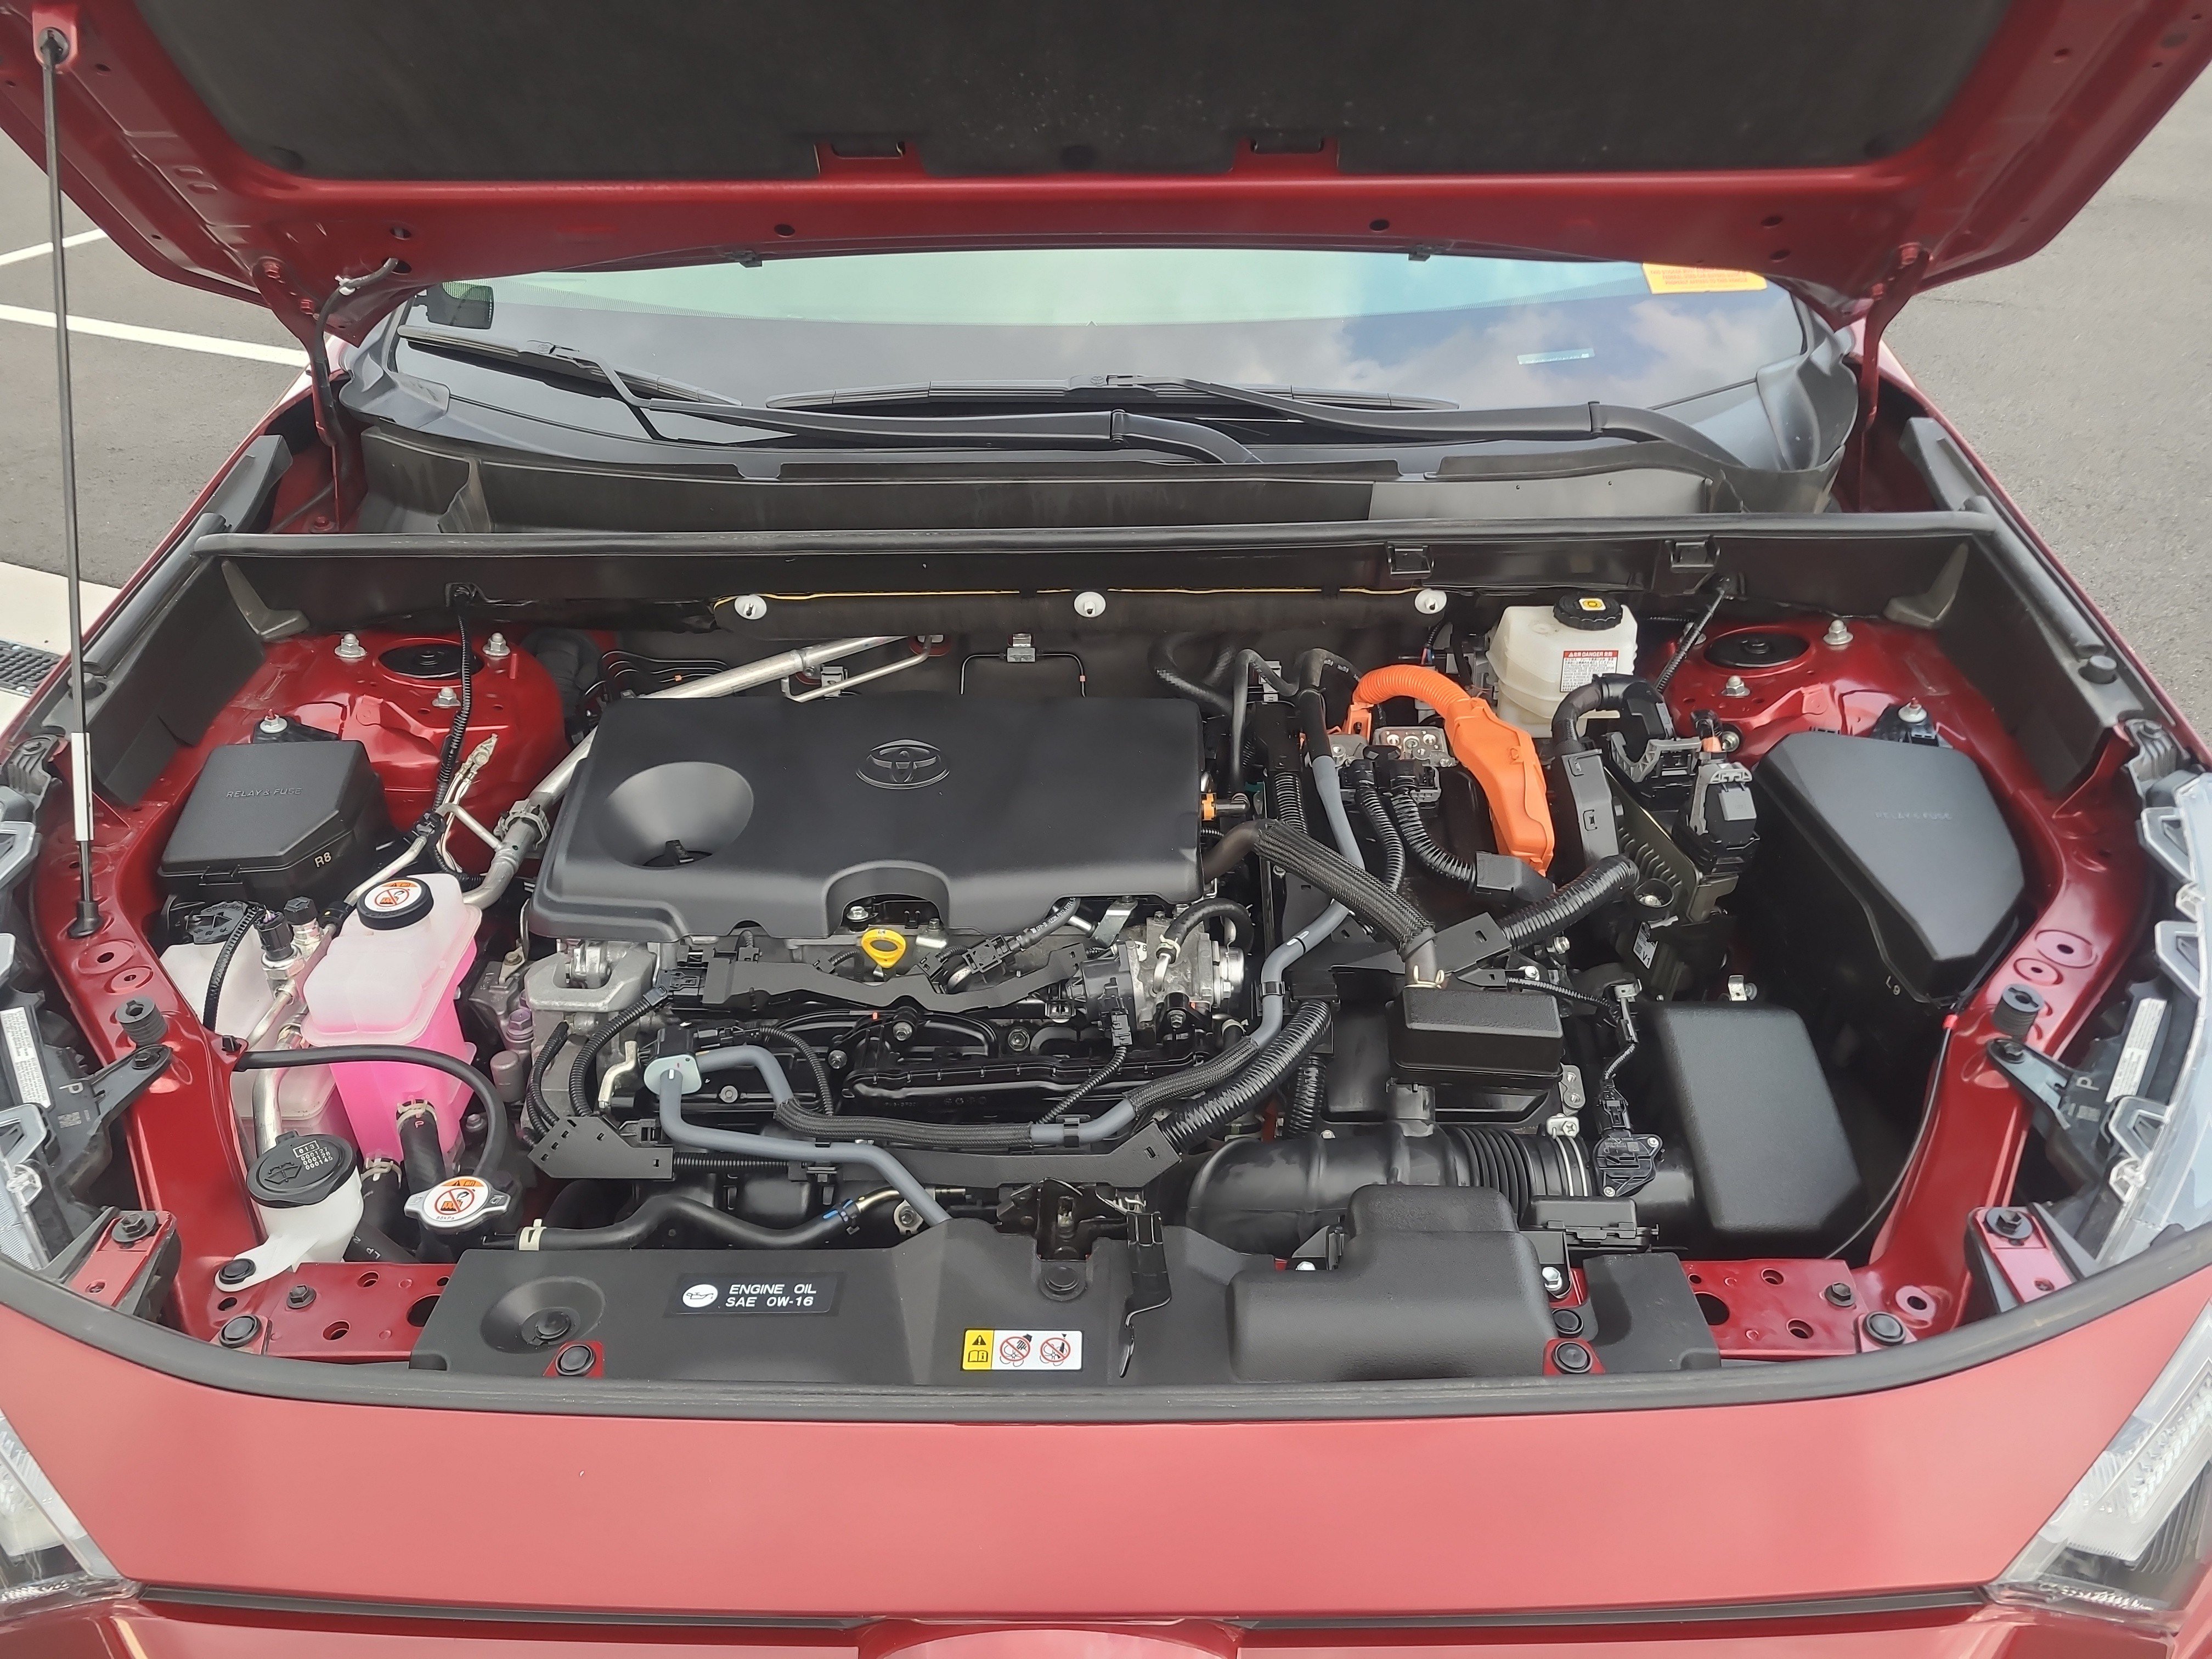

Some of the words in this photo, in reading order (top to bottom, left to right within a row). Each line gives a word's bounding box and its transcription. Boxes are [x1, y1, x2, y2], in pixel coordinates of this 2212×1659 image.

[226, 789, 263, 798] RELAY
[314, 852, 332, 868] R8
[1643, 951, 1651, 966] V1
[1886, 975, 1901, 995] L9
[301, 1147, 328, 1161] 000127
[305, 1156, 333, 1170] 000145
[729, 1284, 785, 1295] ENGINE
[793, 1283, 817, 1294] OIL
[725, 1296, 758, 1307] SAE
[766, 1296, 814, 1307] 0W-16
